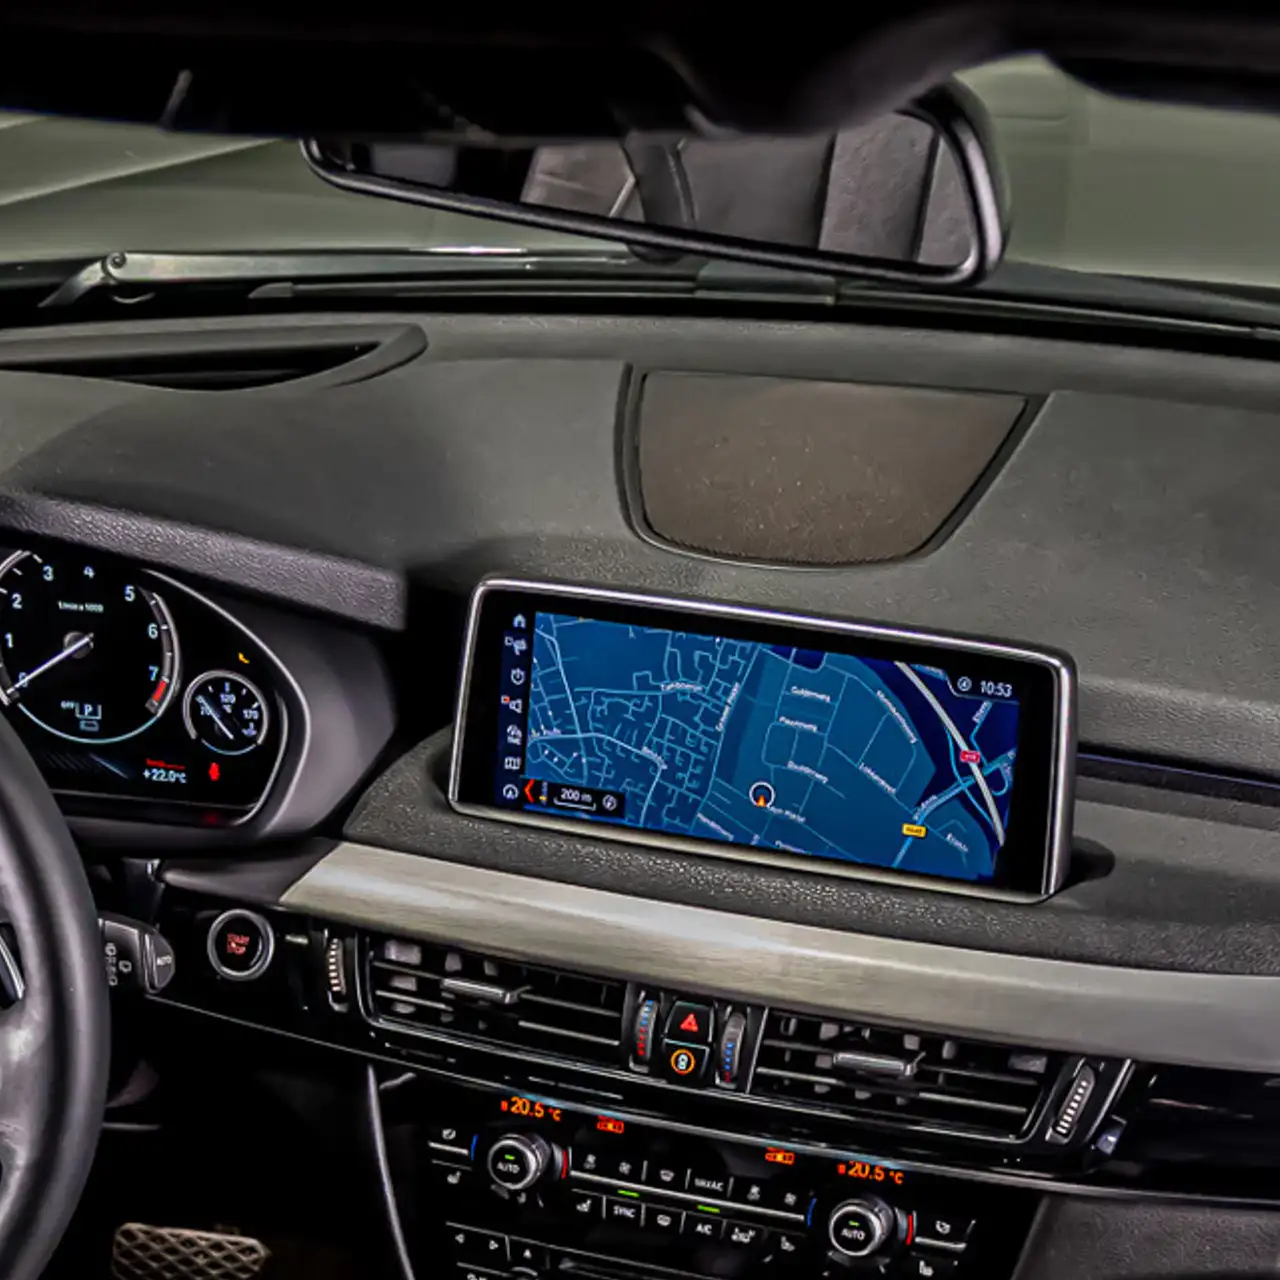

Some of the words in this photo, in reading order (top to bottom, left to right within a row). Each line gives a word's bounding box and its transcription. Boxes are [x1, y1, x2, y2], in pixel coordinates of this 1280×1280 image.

[43, 565, 54, 581] 3
[12, 593, 23, 609] 2
[124, 585, 135, 601] 5
[147, 623, 158, 639] 6
[5, 633, 13, 648] 1
[149, 666, 159, 681] 7
[980, 680, 1012, 698] 10:53
[84, 703, 93, 715] P
[561, 788, 579, 801] 200
[510, 1096, 544, 1117] 20.5
[846, 1160, 886, 1182] 20.5
[612, 1205, 636, 1218] SYNC
[841, 1228, 866, 1241] AUTO
